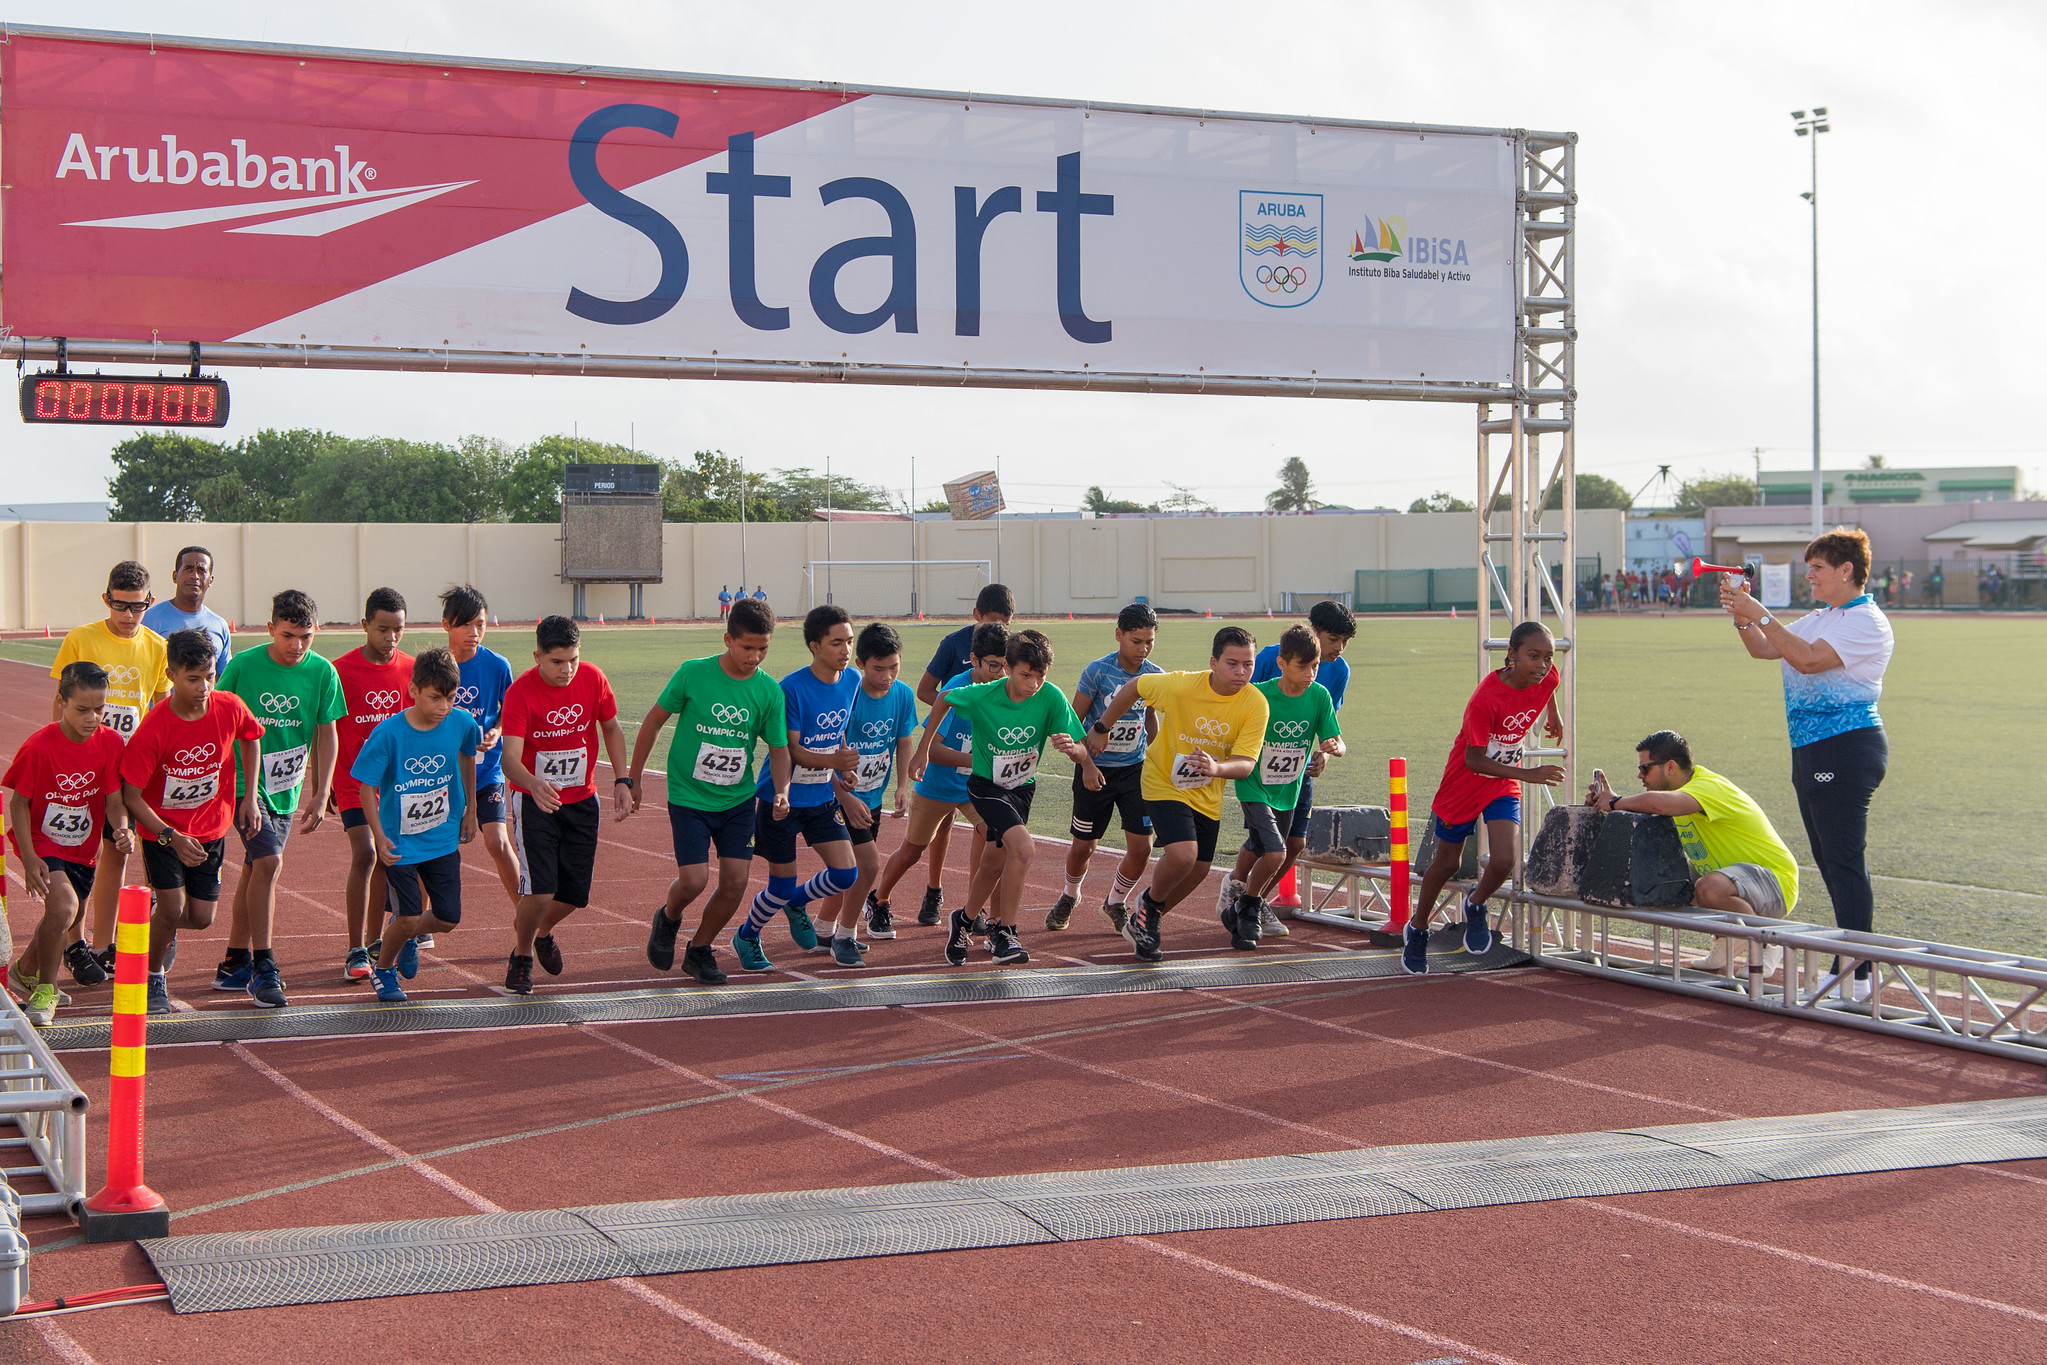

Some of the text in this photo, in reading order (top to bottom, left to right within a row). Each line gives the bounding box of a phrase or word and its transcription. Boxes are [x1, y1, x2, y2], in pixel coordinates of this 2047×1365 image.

[1257, 202, 1306, 218] ARUBA
[566, 103, 1114, 344] Start
[1348, 266, 1471, 283] Instituto Biba Saludabel y Activo
[101, 711, 134, 733] 418
[255, 716, 303, 728] YMPIC DAY
[696, 723, 736, 738] OLYMPIC
[532, 726, 576, 739] OLYMPIC
[1178, 733, 1218, 747] OLYMPIC
[1489, 731, 1522, 742] OLYMP
[848, 740, 885, 750] OLYMPIC
[987, 743, 1026, 756] OLYMPIC
[1262, 740, 1299, 750] OLYMPIC
[162, 763, 205, 777] OLYMPIC
[270, 754, 304, 778] 432
[543, 757, 580, 776] 417
[702, 753, 742, 773] 425
[861, 757, 888, 779] 424
[1000, 757, 1032, 778] 416
[1266, 756, 1300, 773] 421
[170, 780, 214, 801] 423
[394, 773, 454, 793] OLYMPIC DAY
[82, 787, 100, 799] DAY
[407, 796, 445, 820] 422
